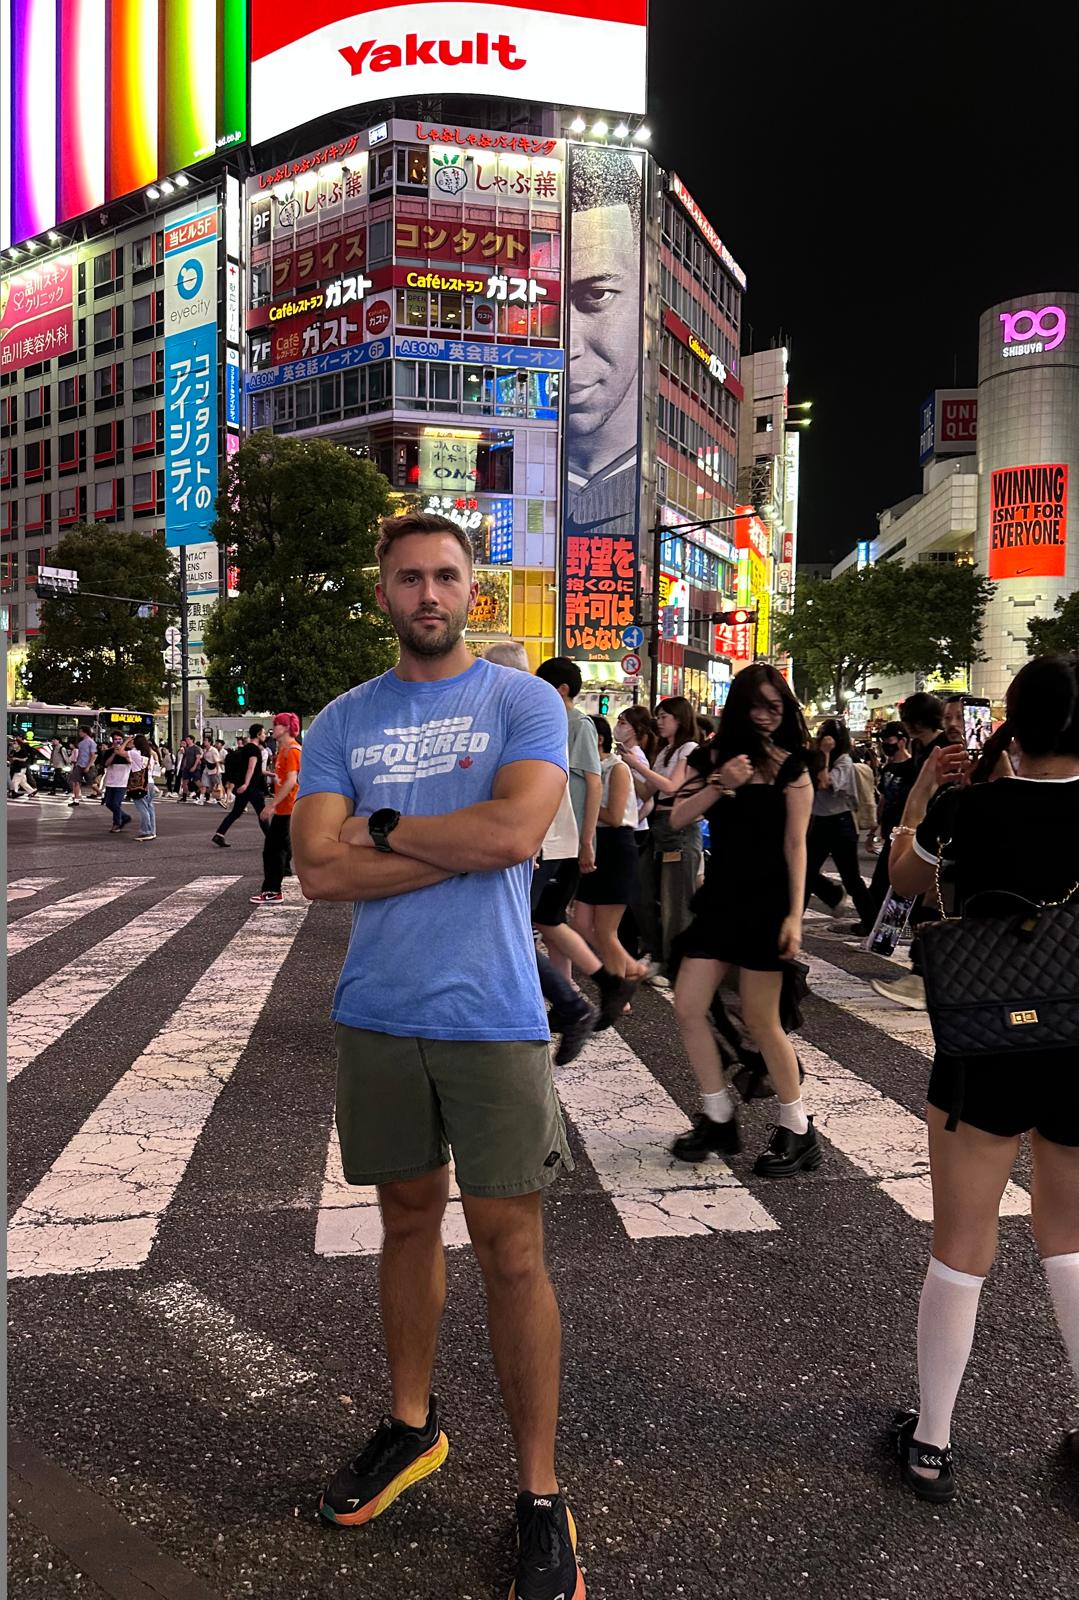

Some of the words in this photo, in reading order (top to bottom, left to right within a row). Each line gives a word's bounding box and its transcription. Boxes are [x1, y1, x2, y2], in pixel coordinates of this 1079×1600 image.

[338, 33, 527, 76] Yakult
[416, 122, 557, 155] しゃぶしゃぶバイキング
[258, 135, 359, 189] しゃぶしゃぶバイキング
[304, 171, 362, 213] しゃぶ葉
[475, 165, 557, 198] しゃぶ葉
[169, 217, 212, 248] 当ビル5F
[253, 211, 270, 231] 9F
[396, 223, 525, 259] コンタクト
[274, 234, 364, 287] プライス
[25, 266, 69, 296] 品川スキン
[25, 286, 64, 313] クリニック
[170, 299, 211, 324] eyecity
[302, 316, 358, 358] ガスト
[369, 314, 389, 327] ガスト
[1000, 306, 1066, 351] 109
[1, 324, 69, 365] 品川美容外科
[252, 341, 271, 364] 7F
[276, 333, 299, 351] Café
[400, 340, 439, 355] AEON
[448, 342, 560, 367] 英会話イーオン
[1003, 342, 1043, 357] SHIBUYA
[250, 370, 275, 388] AEON
[283, 347, 364, 382] 英会話イーオン
[946, 404, 977, 419] UNI
[170, 358, 192, 512] アイシティ
[194, 353, 211, 509] コンタクトの
[992, 466, 1064, 508] WINNING
[992, 504, 1030, 524] ISN'T
[1033, 503, 1064, 519] FOR
[992, 519, 1065, 550] EVERYONE.
[566, 536, 634, 578] 野望を
[566, 577, 634, 592] 抱くのに
[565, 592, 634, 627] 許可は
[352, 732, 490, 770] DSQUARED
[533, 1498, 552, 1508] HOKA
